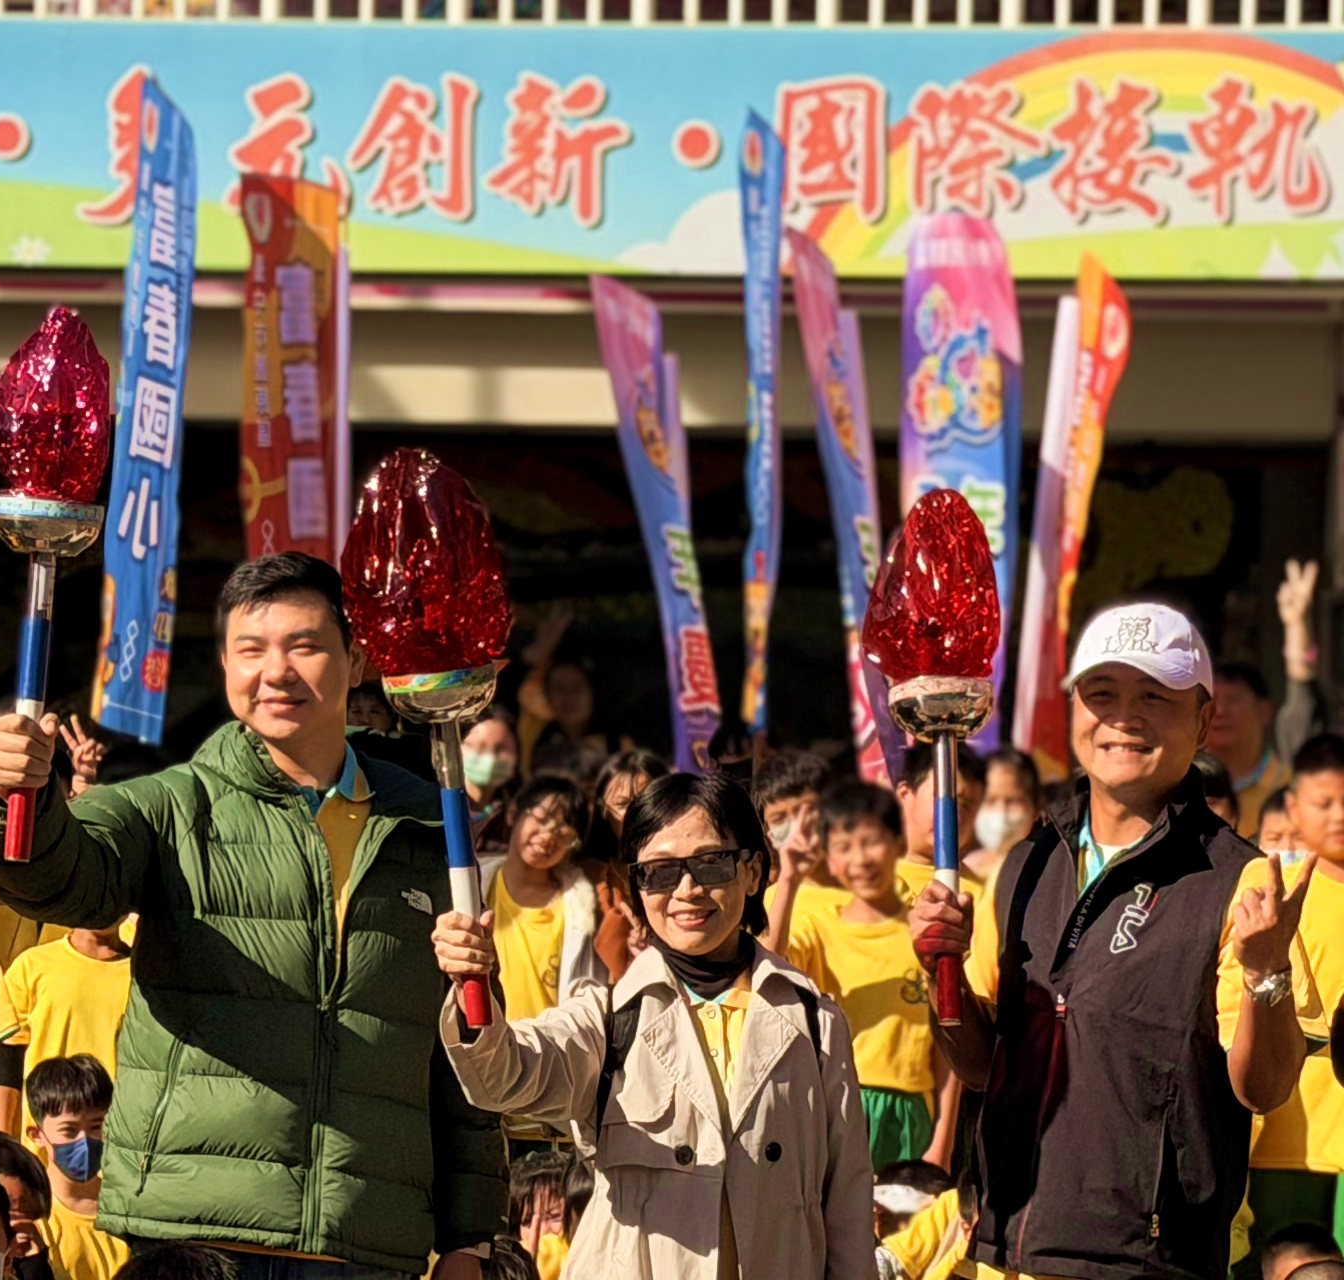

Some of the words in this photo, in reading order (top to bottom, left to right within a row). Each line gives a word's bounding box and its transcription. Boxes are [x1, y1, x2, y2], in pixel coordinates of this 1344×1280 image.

[774, 75, 1332, 226] 國際接軌
[1101, 635, 1161, 655] Lynx
[1110, 883, 1159, 954] FILA
